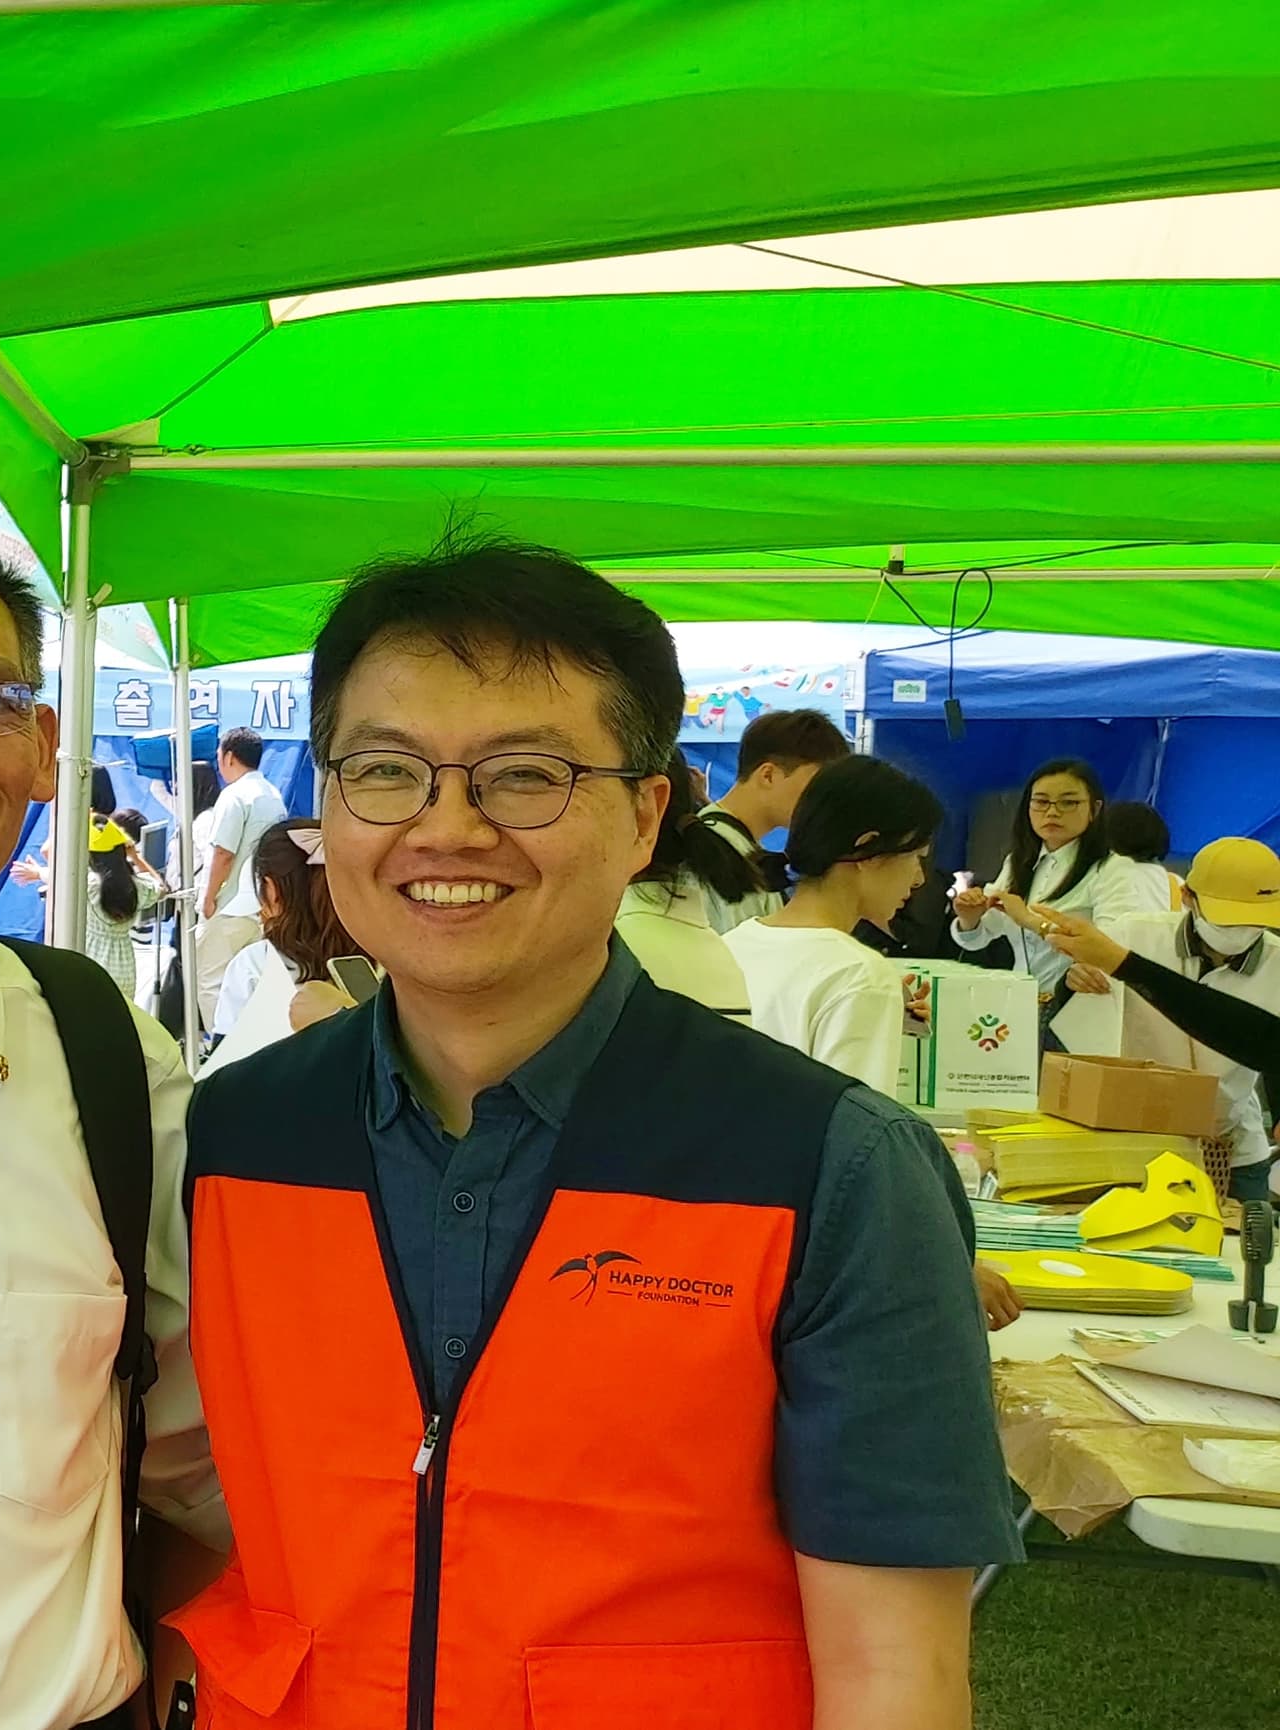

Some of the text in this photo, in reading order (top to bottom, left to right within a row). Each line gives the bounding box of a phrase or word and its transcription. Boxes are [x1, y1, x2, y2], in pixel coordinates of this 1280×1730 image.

[609, 1269, 734, 1298] HAPPY DOCTOR
[637, 1291, 700, 1306] FOUNDATION
